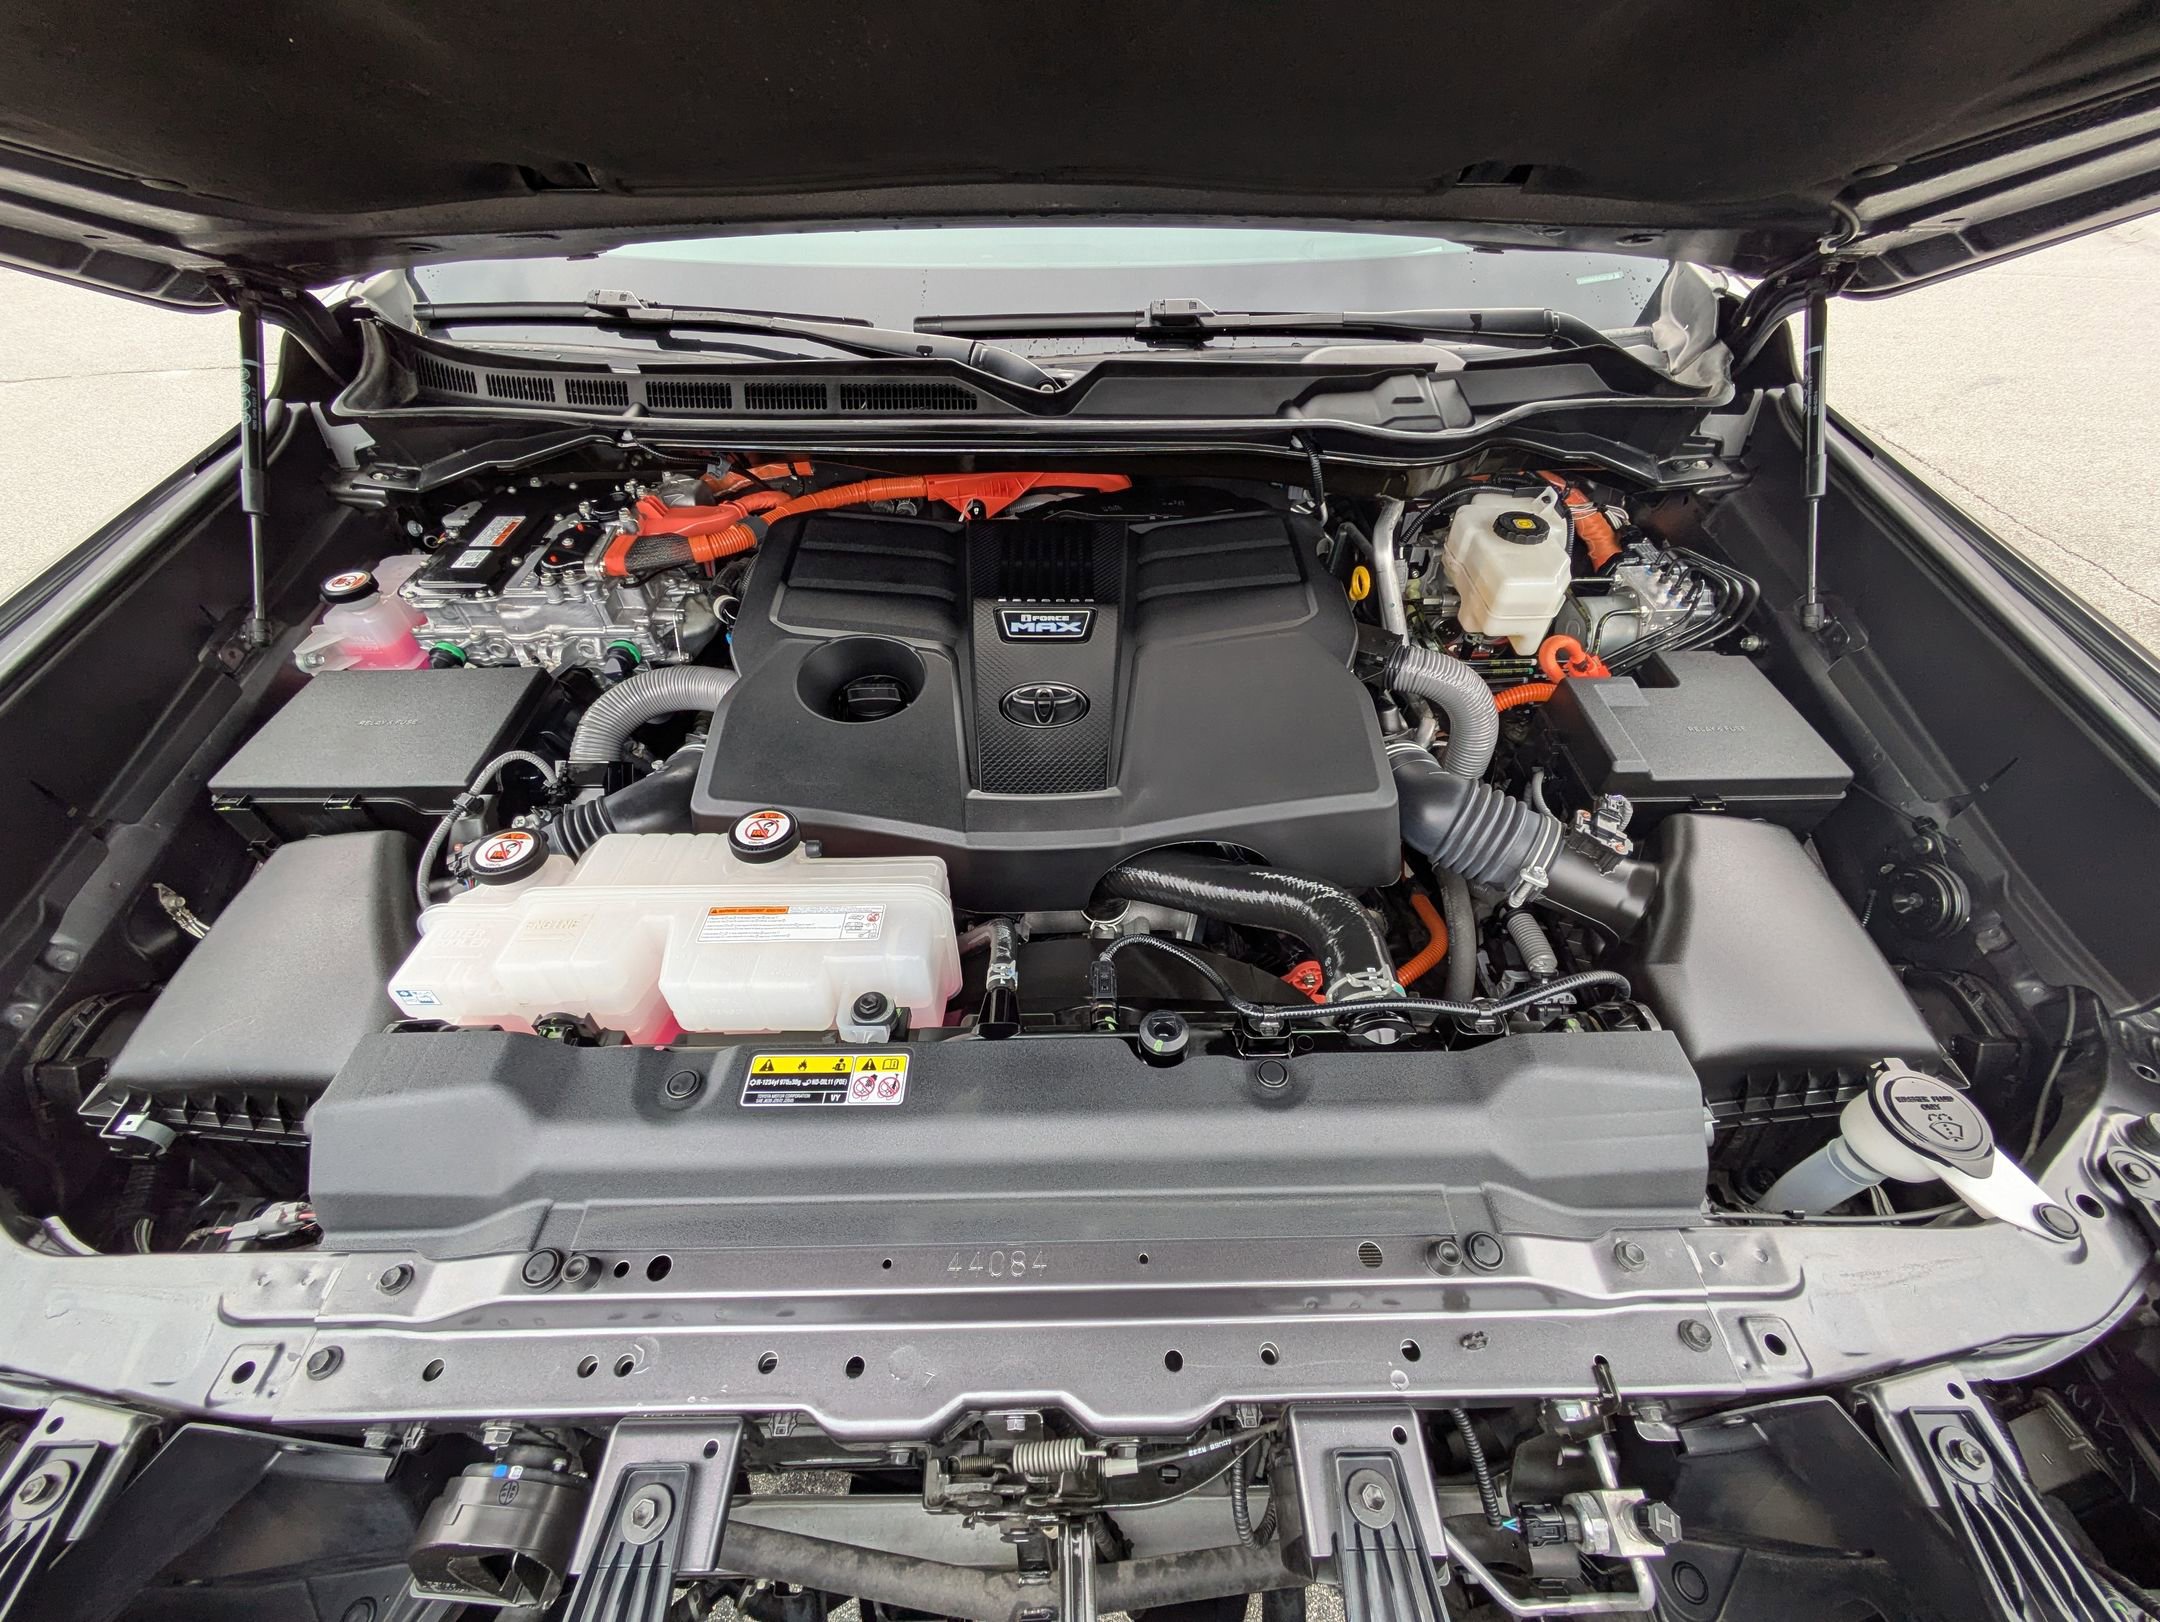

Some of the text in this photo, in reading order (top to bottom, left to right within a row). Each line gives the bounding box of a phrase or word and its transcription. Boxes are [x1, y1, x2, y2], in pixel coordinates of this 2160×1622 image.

[1010, 622, 1082, 632] MAX
[830, 1094, 841, 1102] VY
[947, 1250, 1047, 1278] 44084
